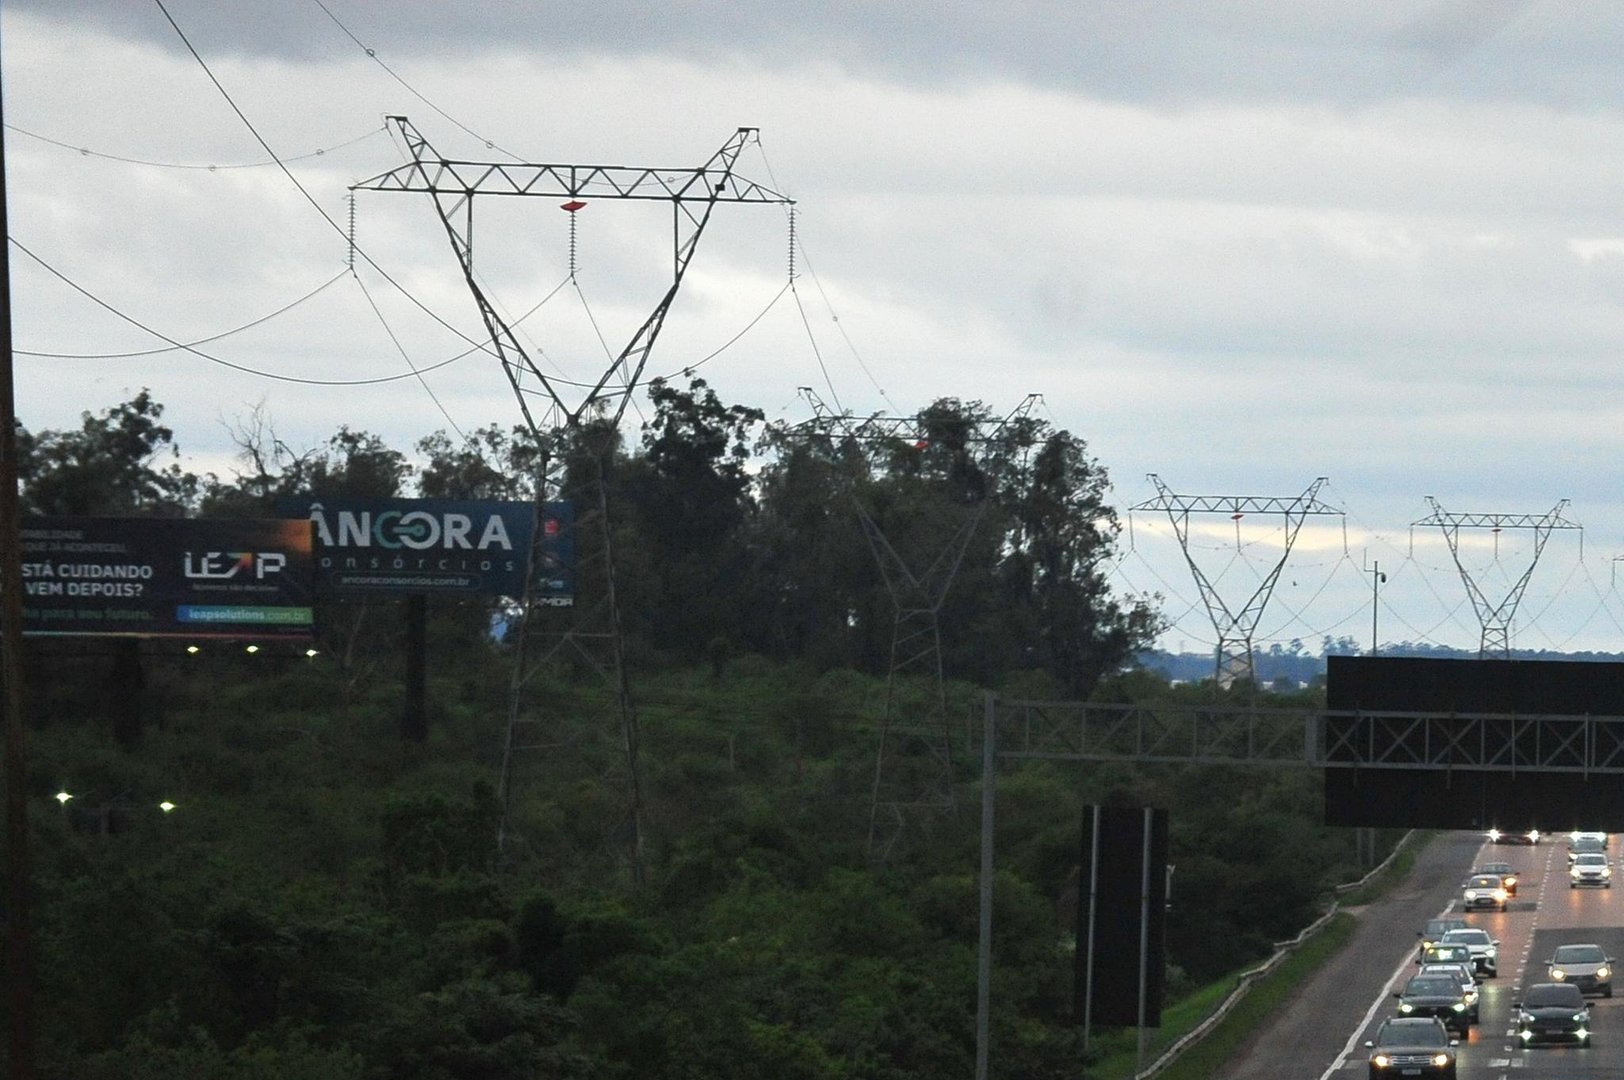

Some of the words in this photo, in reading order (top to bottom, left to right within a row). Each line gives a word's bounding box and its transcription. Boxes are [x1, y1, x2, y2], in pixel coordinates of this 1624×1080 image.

[309, 502, 514, 551] ÂNCORA
[21, 560, 54, 578] STÁ
[57, 563, 153, 580] CUIDANDO
[320, 555, 515, 573] onsórcios
[24, 581, 63, 596] VEM
[66, 582, 144, 598] DEPOIS?
